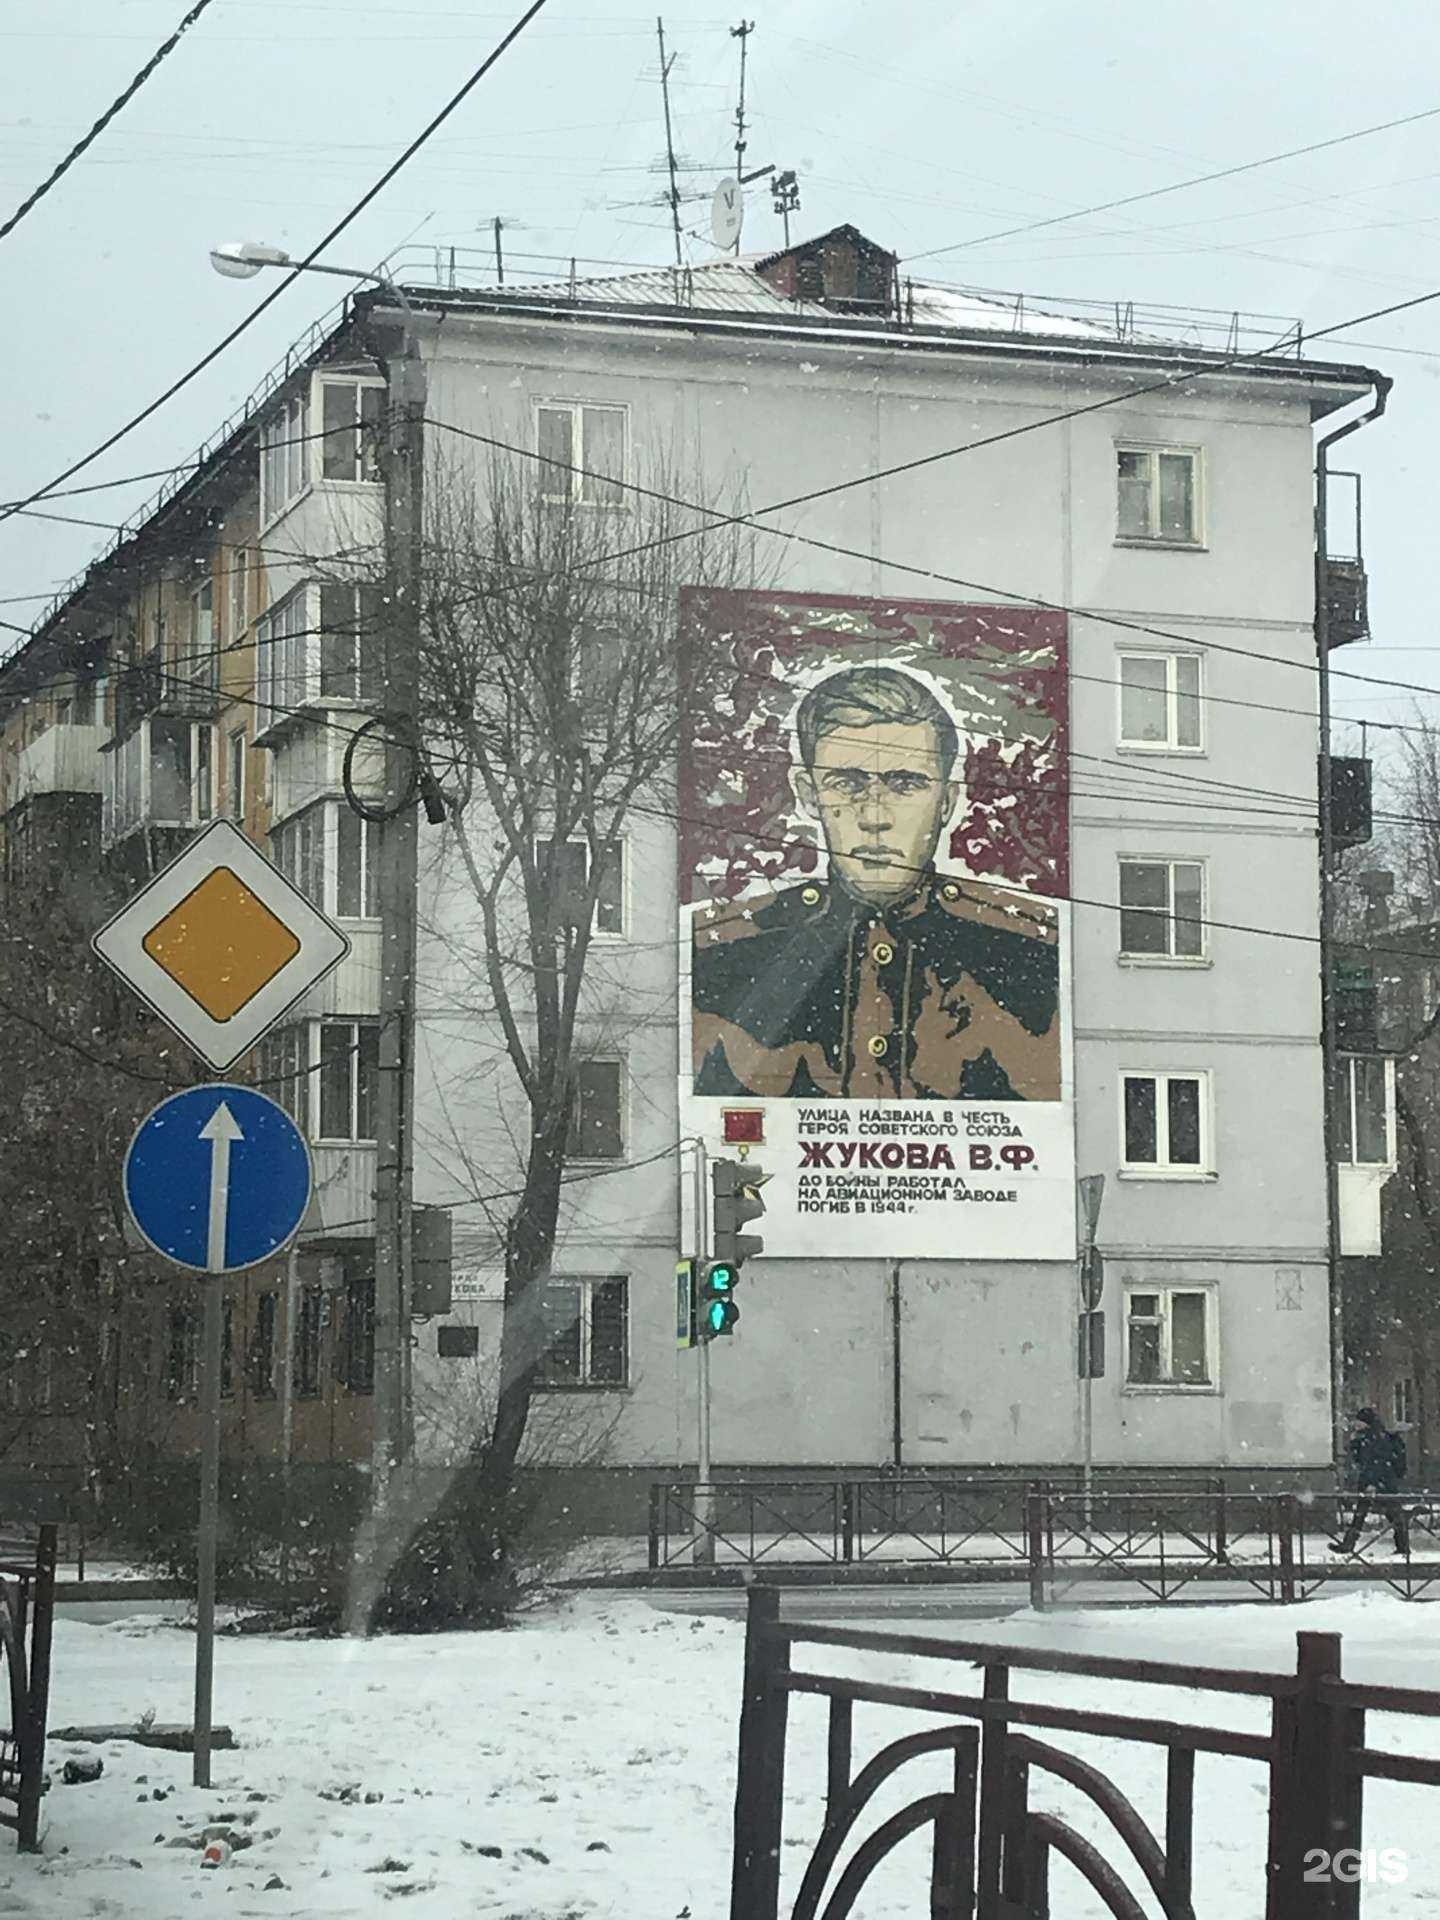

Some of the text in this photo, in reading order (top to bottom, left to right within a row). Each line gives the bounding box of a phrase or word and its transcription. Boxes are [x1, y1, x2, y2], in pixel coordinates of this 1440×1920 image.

[798, 1108, 1011, 1124] УЛИЦА НАЗВАНА В ЧЕСТЬ
[798, 1122, 1023, 1137] ГЕРОЯ СОВЕТСКОГО СОЮЗА
[797, 1141, 956, 1170] ЖУКОВА
[798, 1172, 966, 1189] ДО ВОЙНЫ РАБОТАЛ
[798, 1187, 1018, 1202] НА АВИАЦИОННОМ ЗАВОДЕ
[798, 1201, 850, 1213] ПОГИБ
[855, 1202, 866, 1213] В
